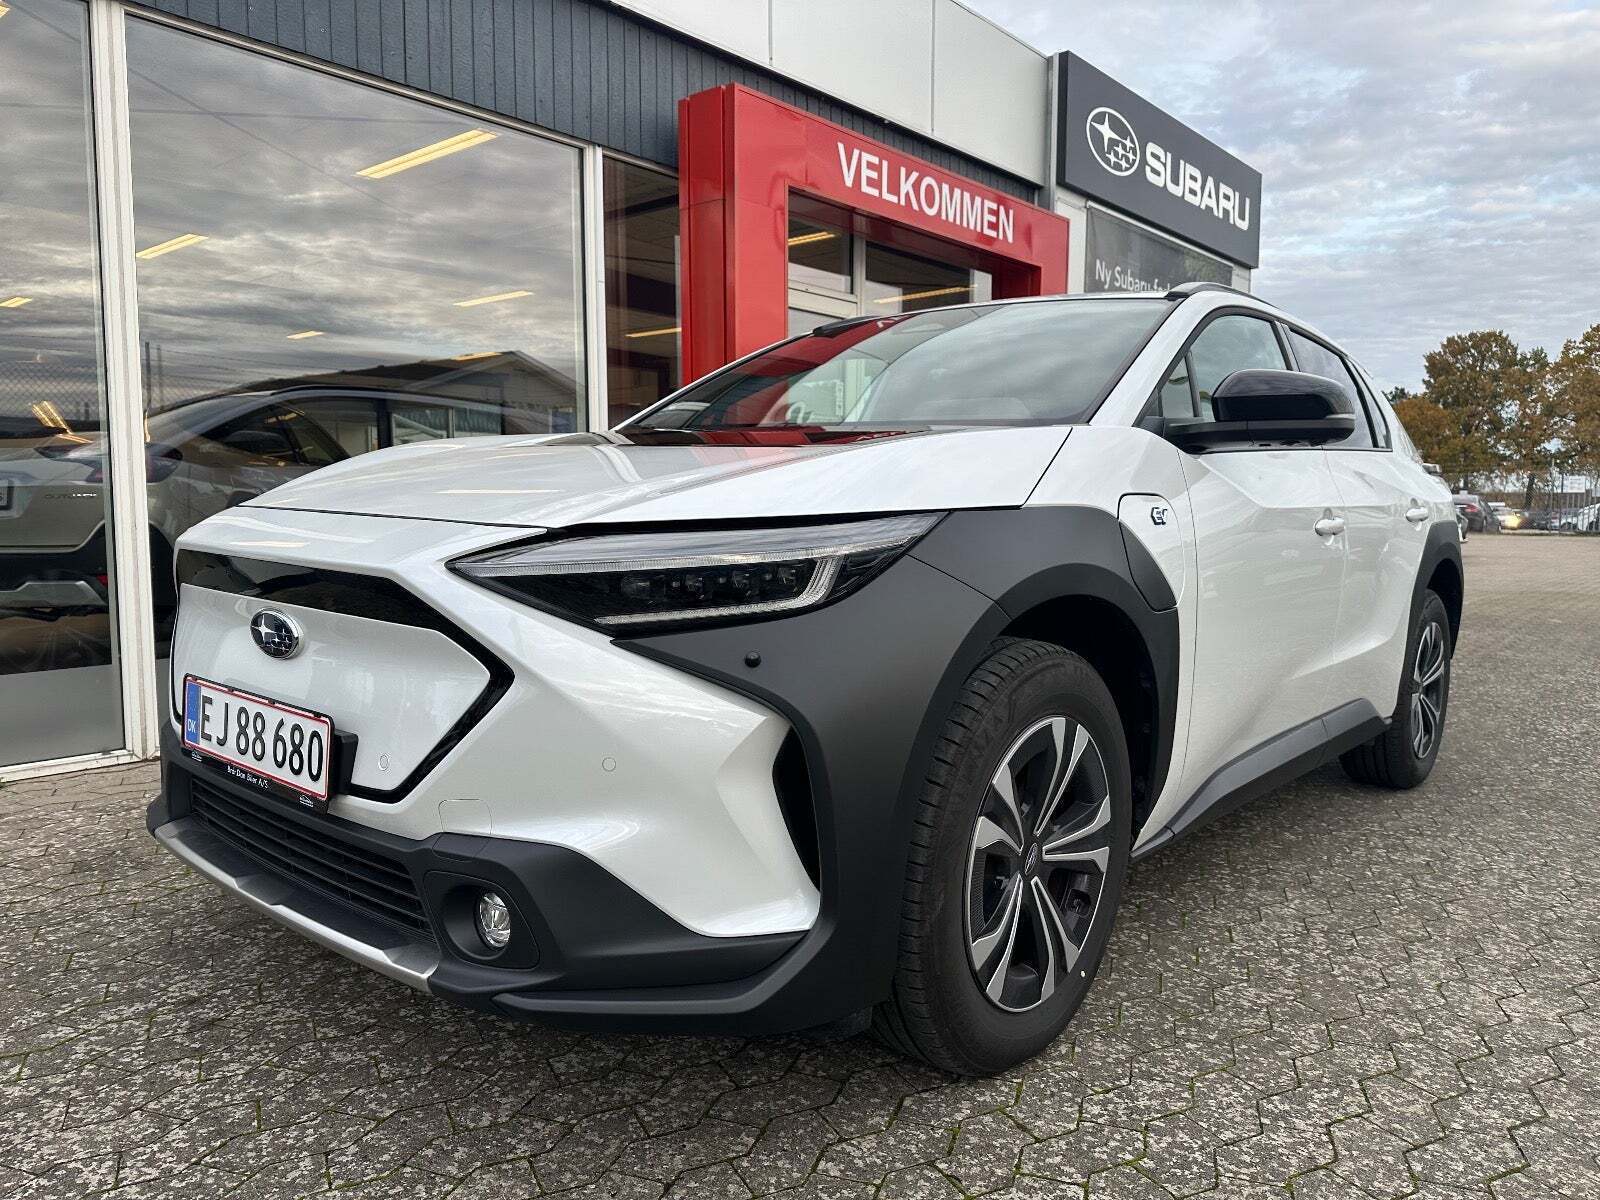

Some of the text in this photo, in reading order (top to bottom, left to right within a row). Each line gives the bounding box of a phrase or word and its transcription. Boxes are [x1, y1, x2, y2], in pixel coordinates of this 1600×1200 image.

[837, 142, 1014, 244] VELKOMMEN
[1145, 142, 1250, 230] SUBARU
[1095, 259, 1112, 289] Ny
[187, 718, 196, 733] DK
[200, 694, 323, 782] EJ 88 680
